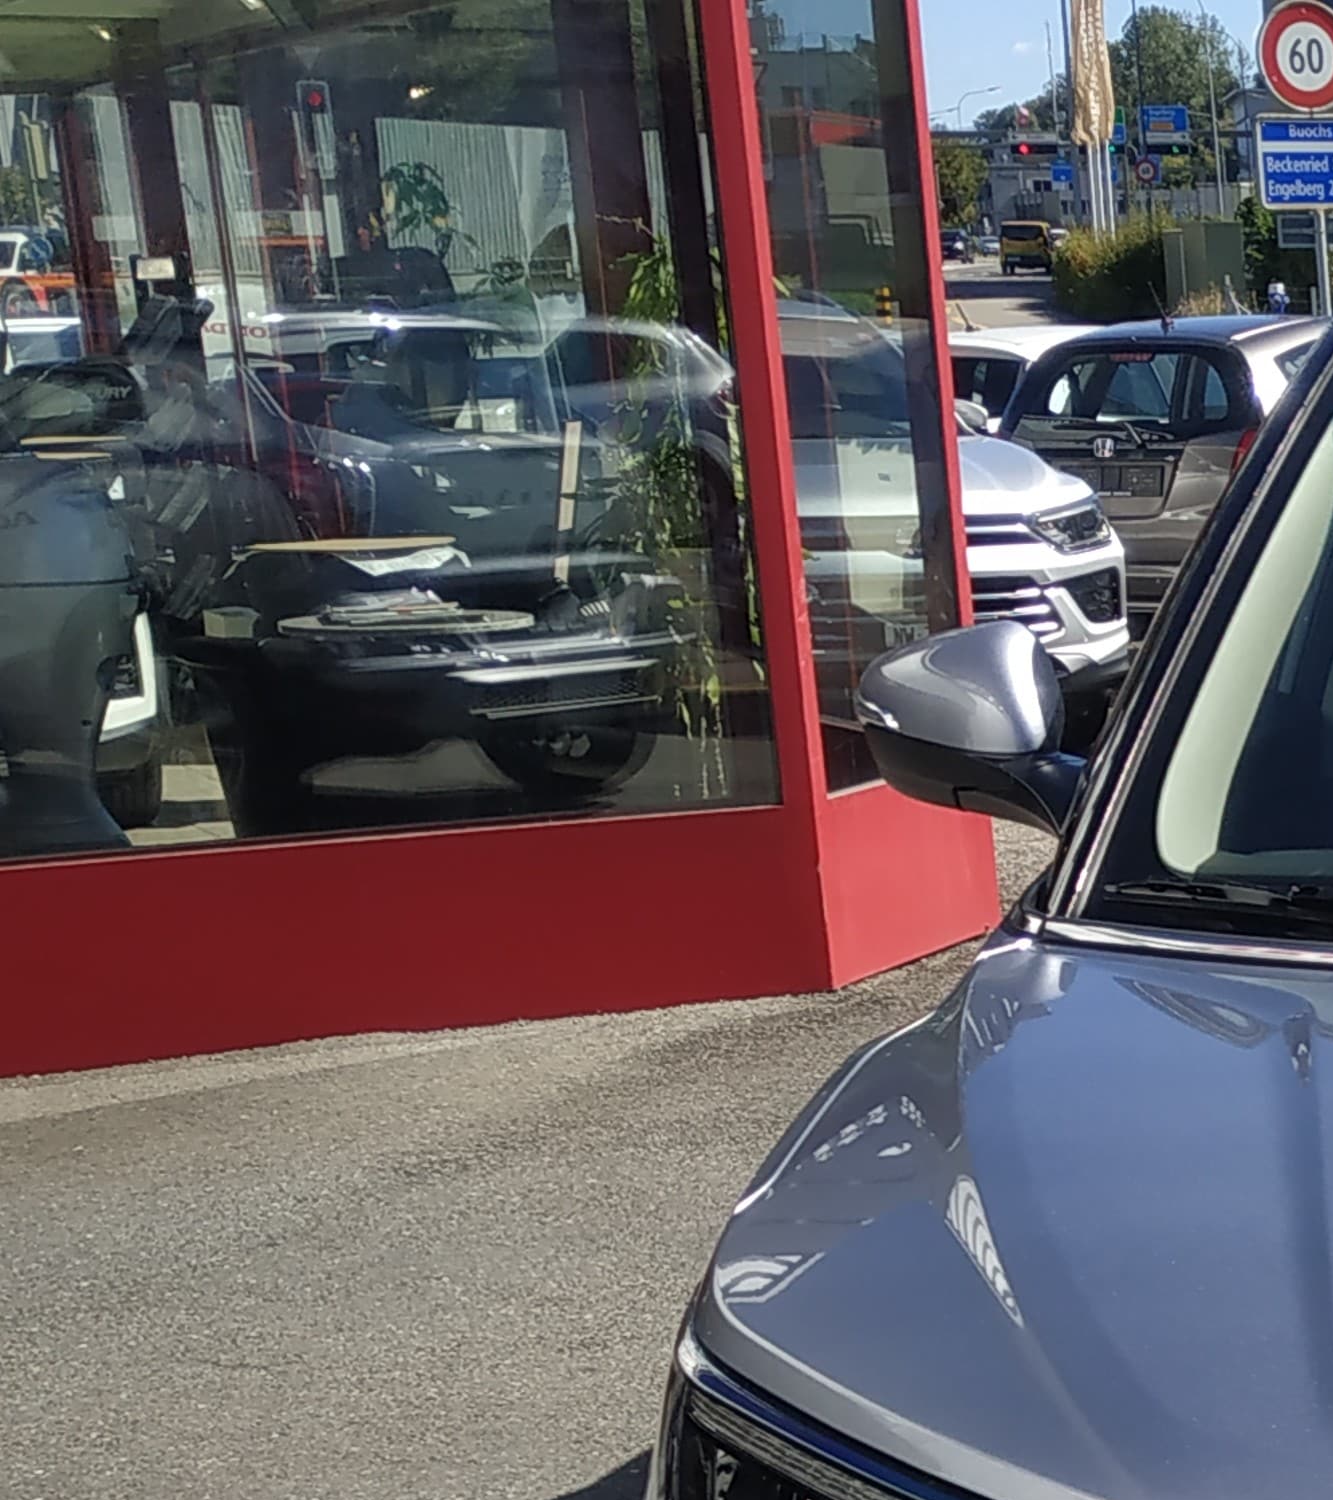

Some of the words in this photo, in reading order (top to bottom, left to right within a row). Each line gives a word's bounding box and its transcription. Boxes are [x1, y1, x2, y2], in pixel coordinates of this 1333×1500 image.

[1289, 37, 1324, 74] 60
[1288, 123, 1333, 138] Buochs
[1266, 155, 1330, 173] Beckenried
[1268, 179, 1326, 201] Engelberg
